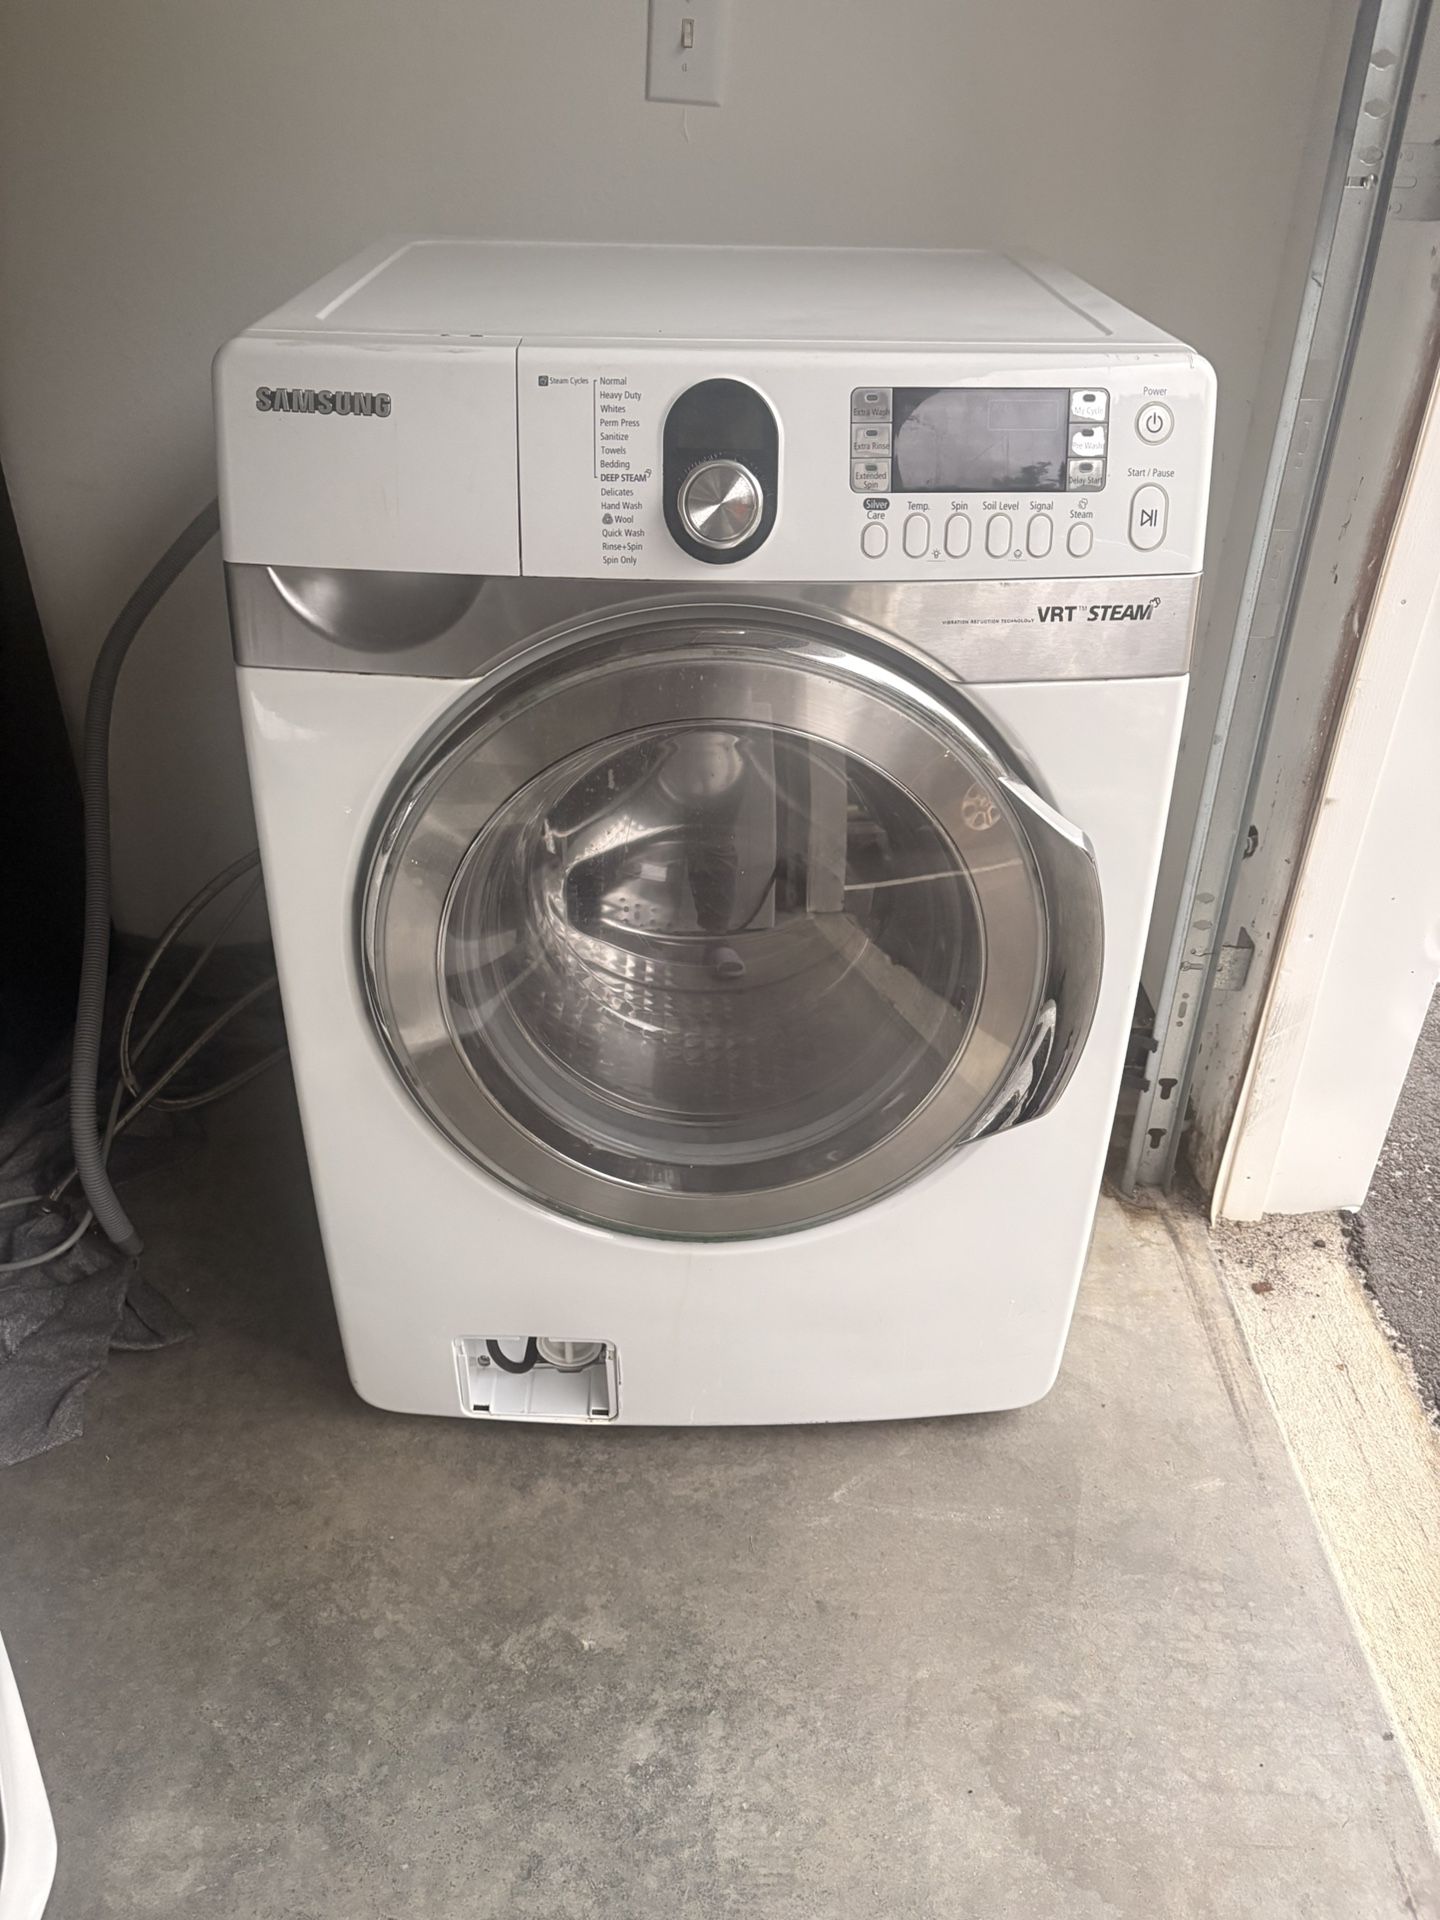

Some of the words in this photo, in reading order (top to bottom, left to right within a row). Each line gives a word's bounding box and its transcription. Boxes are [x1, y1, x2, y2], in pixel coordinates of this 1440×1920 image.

[549, 377, 569, 385] Steam
[570, 377, 589, 386] Cycles
[600, 377, 627, 385] Normal
[600, 391, 623, 401] Heavy
[624, 391, 641, 401] Duty
[1143, 386, 1167, 396] Power
[256, 386, 391, 418] SAMSUNG
[600, 405, 626, 413] Whites
[853, 407, 871, 417] Extra
[600, 419, 619, 427] Perm
[621, 419, 640, 427] Press
[600, 432, 629, 441] Sanitize
[601, 446, 626, 455] Towels
[853, 442, 871, 451] Extra
[872, 442, 890, 451] Rinse
[600, 460, 630, 470] Bedding
[600, 473, 619, 481] DEEP
[620, 473, 647, 482] STEAM
[855, 471, 887, 480] Extended
[1128, 468, 1145, 477] Start
[1152, 468, 1175, 478] Pause
[863, 480, 878, 489] Spin
[1068, 475, 1086, 486] Delay
[600, 487, 634, 497] Delicates
[601, 501, 620, 510] Hand
[622, 501, 643, 510] Wash
[866, 499, 888, 509] Silver
[908, 501, 930, 512] Temp.
[951, 501, 968, 511] Spin
[982, 501, 997, 510] Soil
[999, 501, 1019, 510] Level
[1030, 501, 1053, 512] Signal
[867, 510, 885, 519] Care
[1070, 509, 1093, 518] Steam
[614, 515, 634, 523] Wool
[602, 528, 623, 538] Quick
[624, 528, 645, 537] Wash
[602, 542, 643, 552] Rinse+Spin
[602, 555, 619, 565] Spin
[620, 555, 637, 566] Only
[1037, 606, 1077, 622] VRT
[1087, 604, 1154, 621] STEAM
